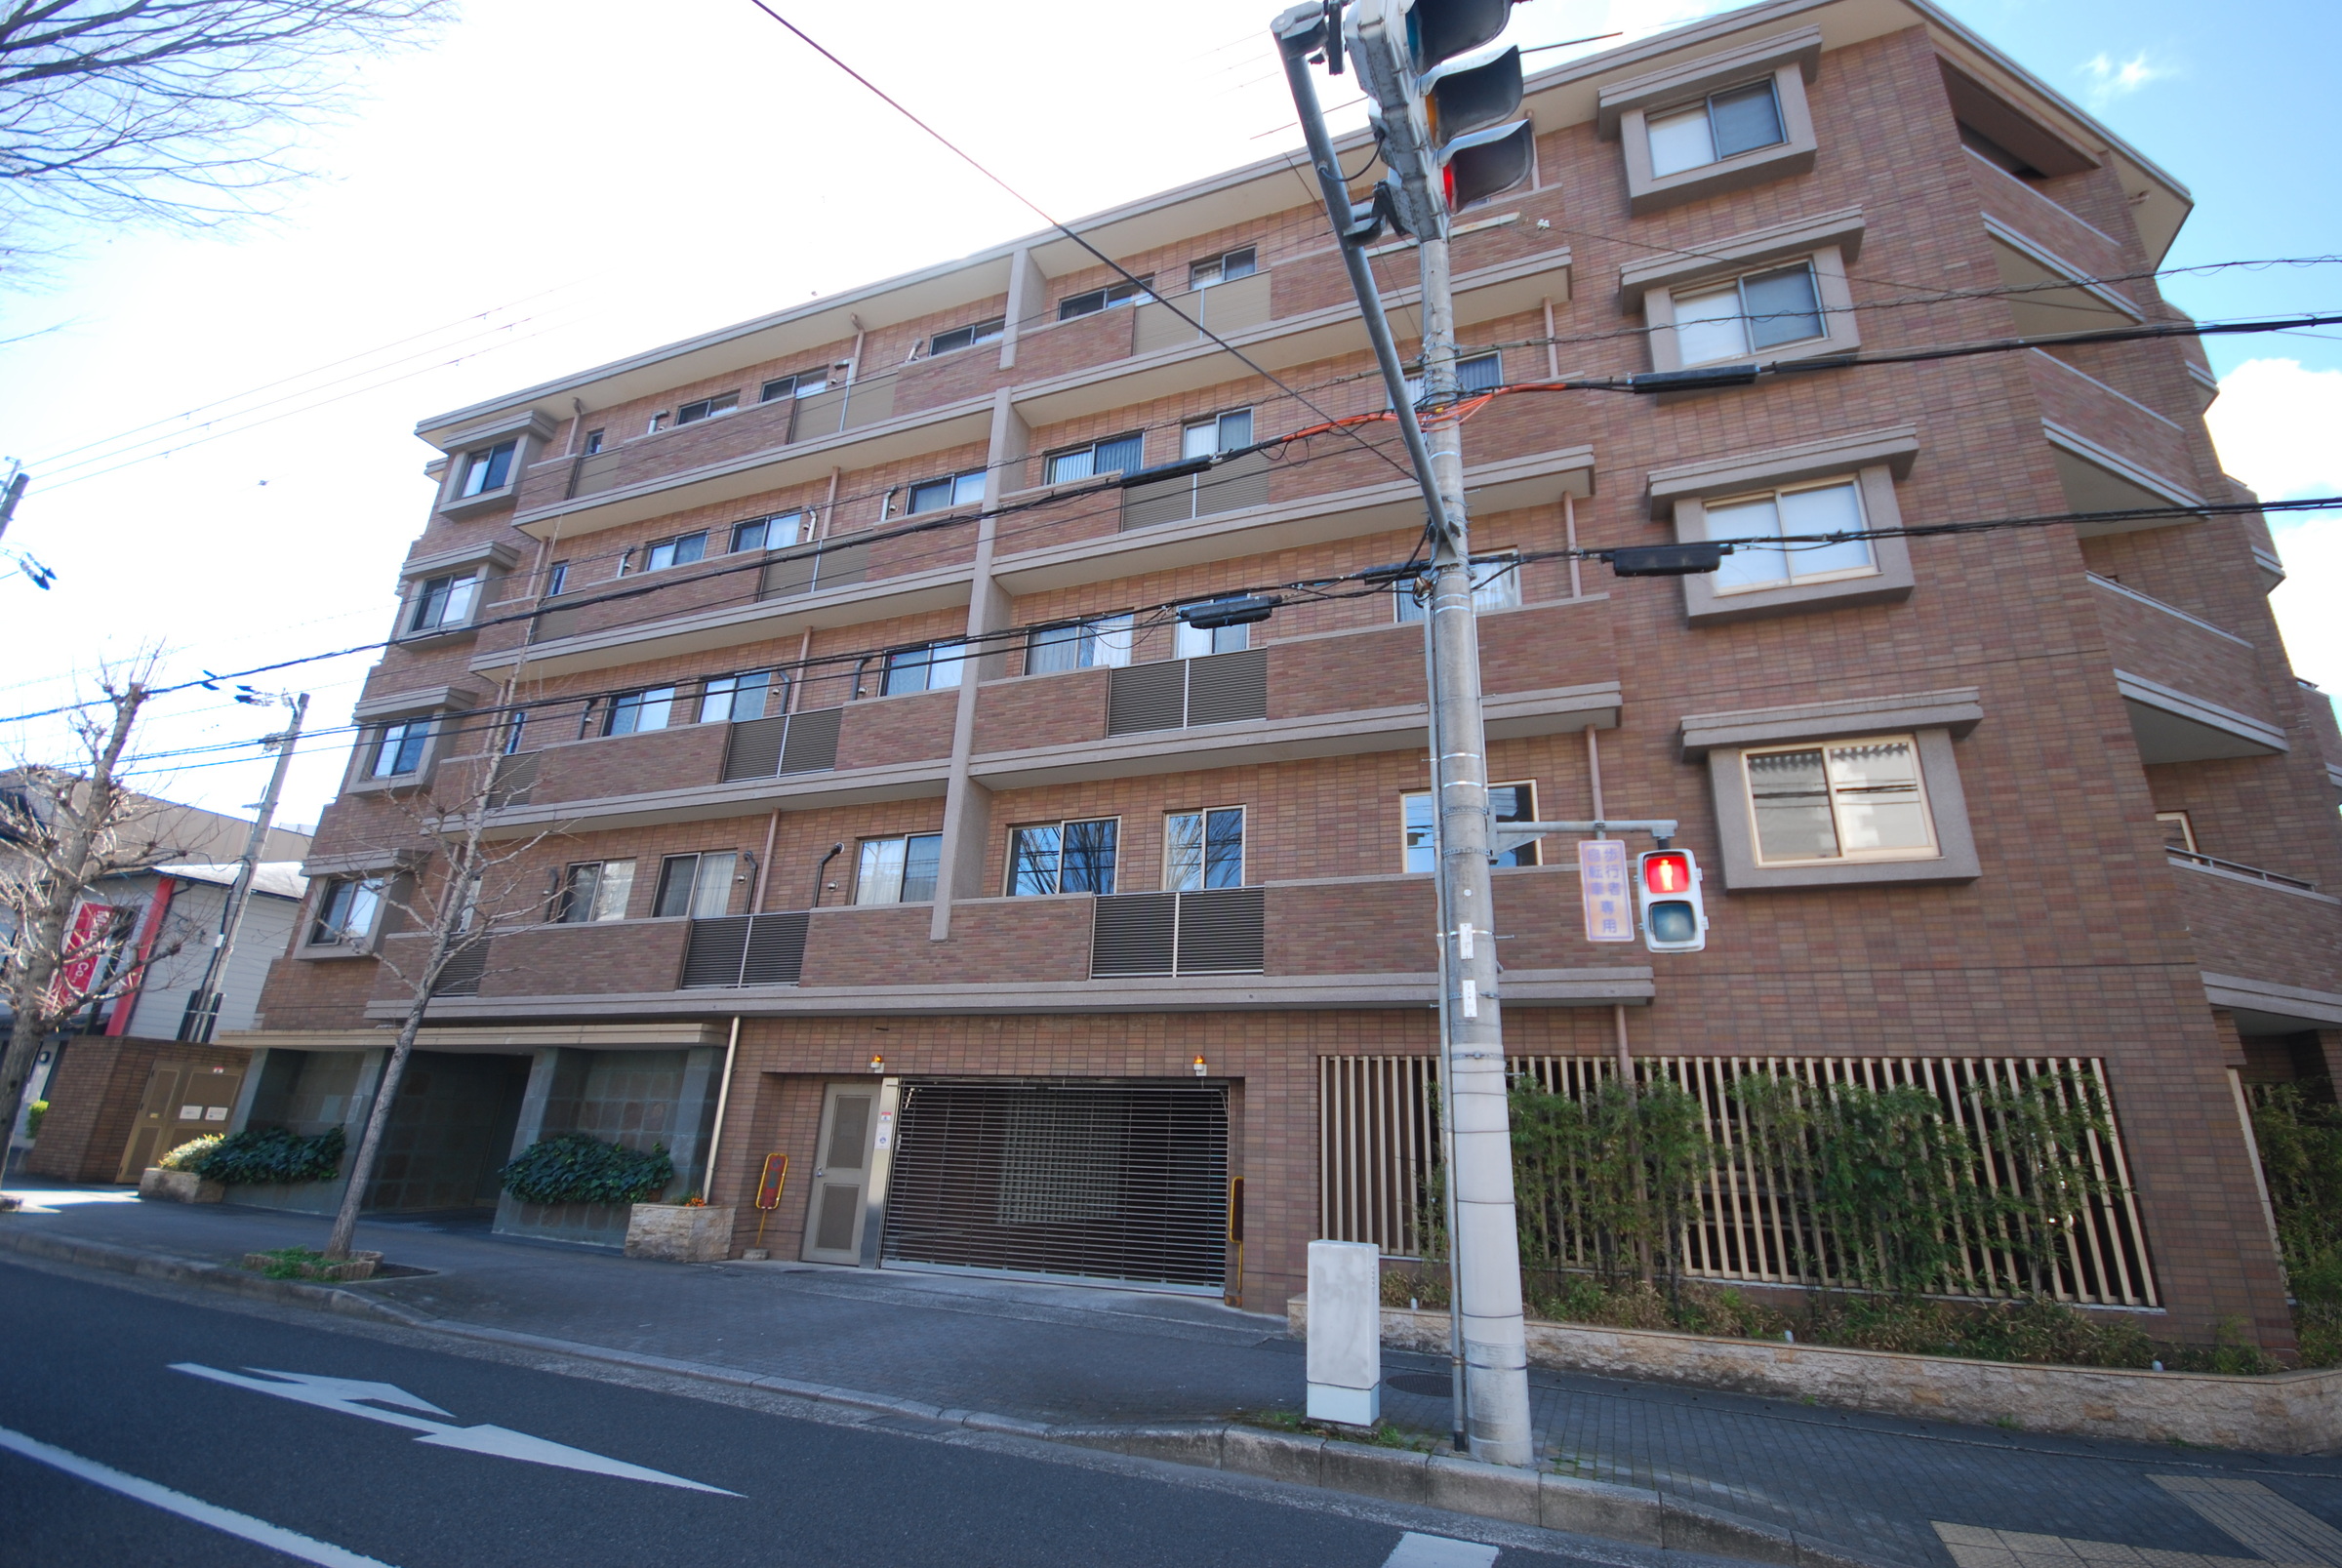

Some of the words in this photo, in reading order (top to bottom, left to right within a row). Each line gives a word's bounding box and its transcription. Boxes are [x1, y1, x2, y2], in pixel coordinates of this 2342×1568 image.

[1587, 848, 1604, 896] 自転車
[1604, 848, 1622, 896] 歩行者
[1600, 900, 1617, 934] 専用
